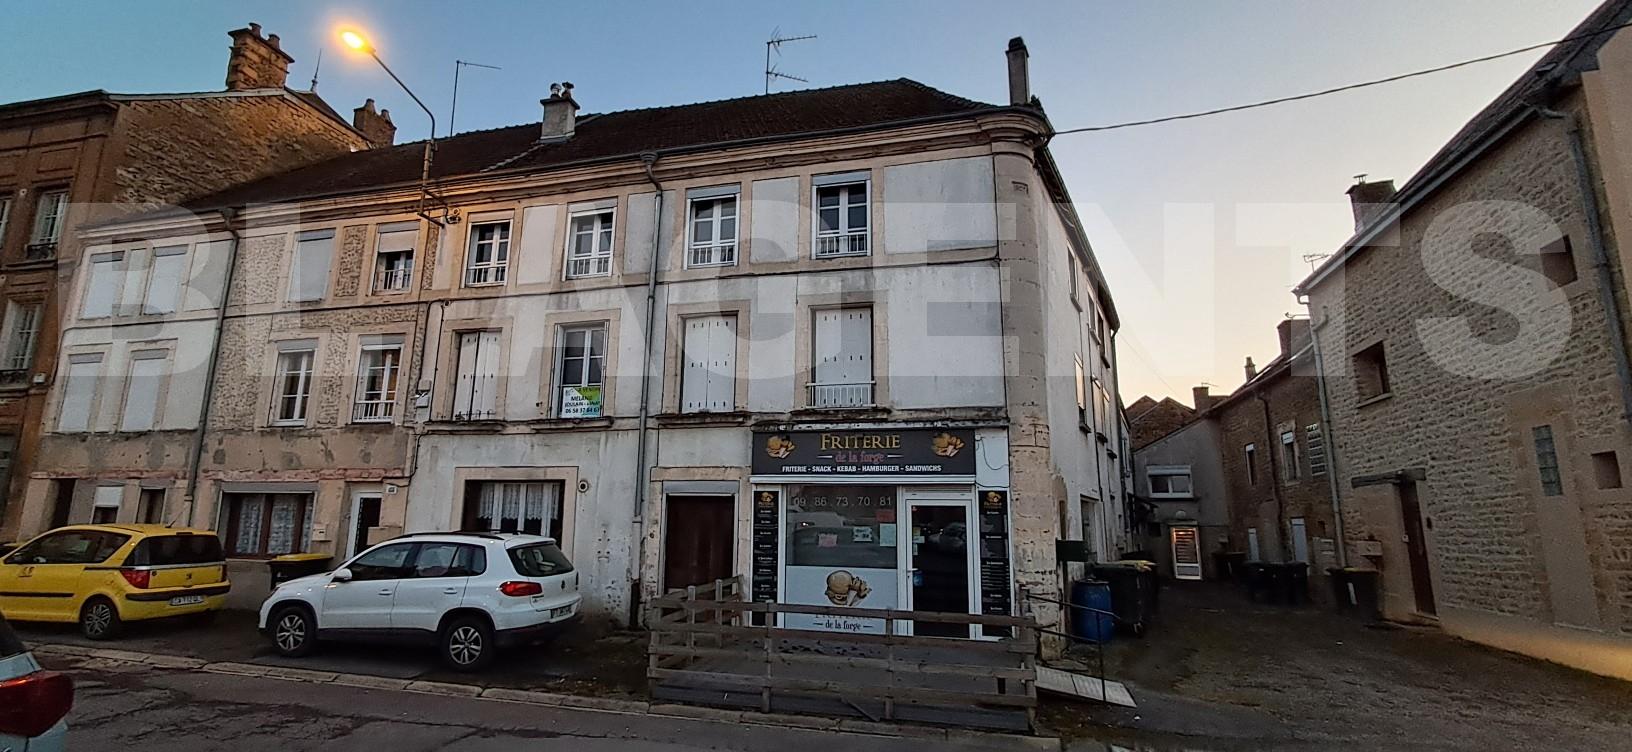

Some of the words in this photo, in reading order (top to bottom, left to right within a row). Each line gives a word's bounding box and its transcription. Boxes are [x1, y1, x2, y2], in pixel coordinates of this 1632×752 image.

[836, 451, 846, 462] de
[848, 451, 858, 462] la
[860, 451, 885, 464] forge
[793, 497, 806, 506] 09
[835, 496, 849, 506] 73
[857, 496, 871, 506] 70
[879, 496, 891, 506] 81
[825, 619, 833, 629] de
[835, 619, 842, 629] la
[843, 620, 861, 631] forge
